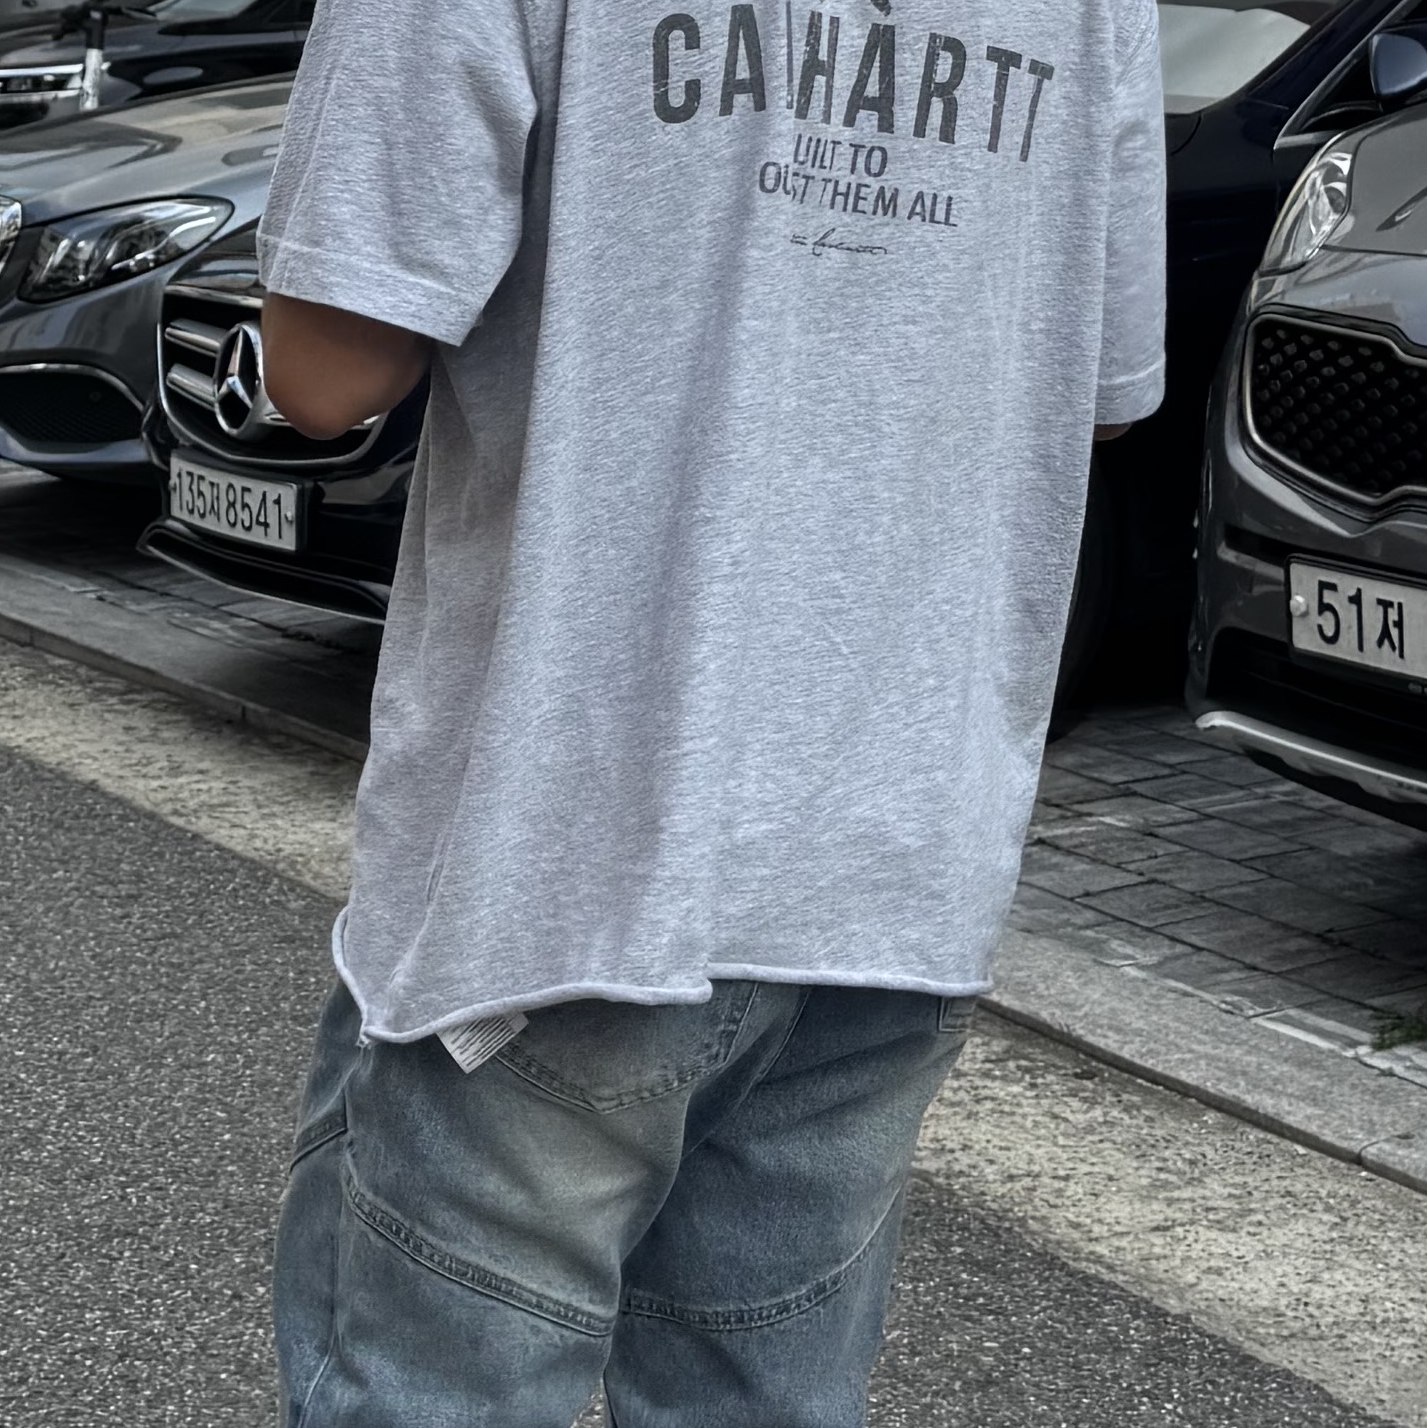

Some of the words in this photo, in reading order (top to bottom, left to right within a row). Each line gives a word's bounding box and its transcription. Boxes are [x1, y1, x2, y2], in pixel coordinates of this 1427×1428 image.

[652, 2, 1055, 163] CAHARTT
[849, 142, 889, 178] TO
[820, 177, 900, 213] THEM
[907, 191, 959, 227] ALL
[1317, 580, 1405, 660] 51저
